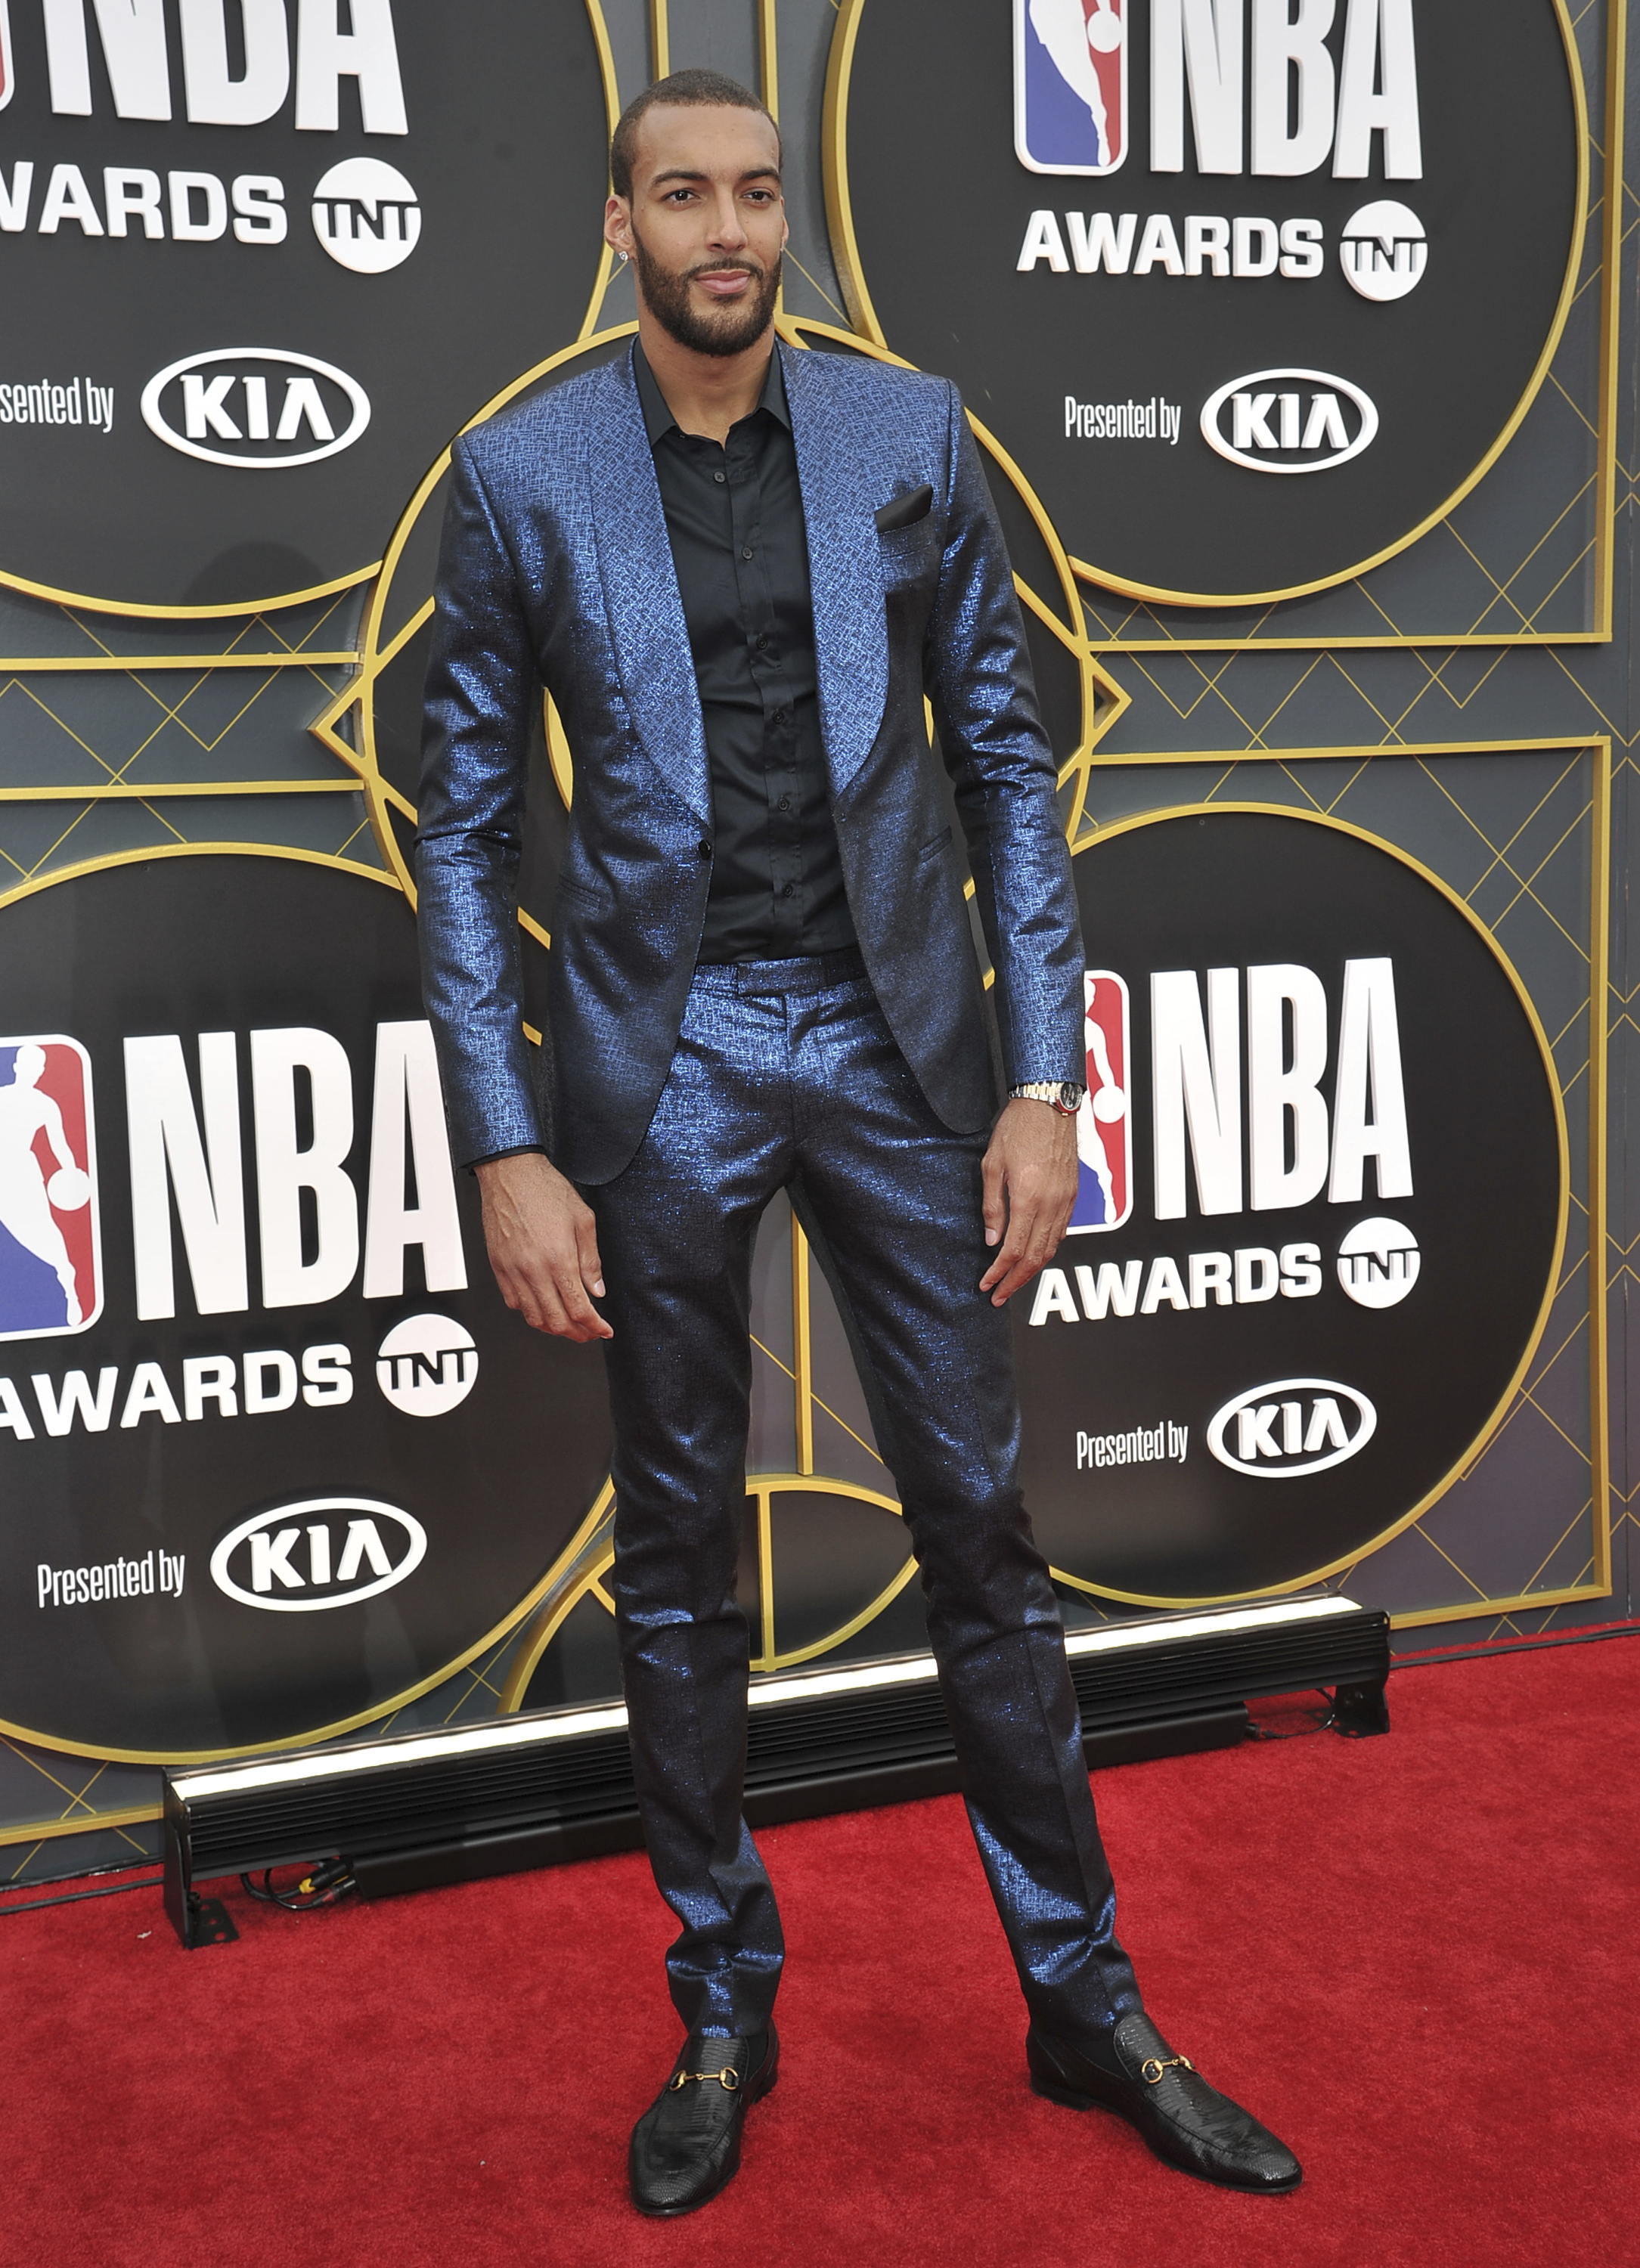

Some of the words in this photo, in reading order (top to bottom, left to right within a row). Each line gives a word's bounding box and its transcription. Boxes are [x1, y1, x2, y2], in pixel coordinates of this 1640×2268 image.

[1150, 0, 1423, 180] NBA
[1016, 210, 1324, 278] AWARDS
[85, 376, 113, 433] by
[180, 375, 335, 440] KIA
[1065, 396, 1157, 438] Presented
[1159, 397, 1181, 446] by
[1231, 393, 1350, 449] KIA
[1150, 957, 1414, 1220] NBA
[123, 1020, 468, 1321] NBA
[1029, 1243, 1322, 1326] AWARDS
[1077, 1421, 1165, 1470] Presented
[1168, 1420, 1189, 1464] by
[1236, 1398, 1349, 1460] KIA
[38, 1550, 155, 1609] Presented
[158, 1549, 185, 1598] by
[248, 1519, 392, 1593] KIA
